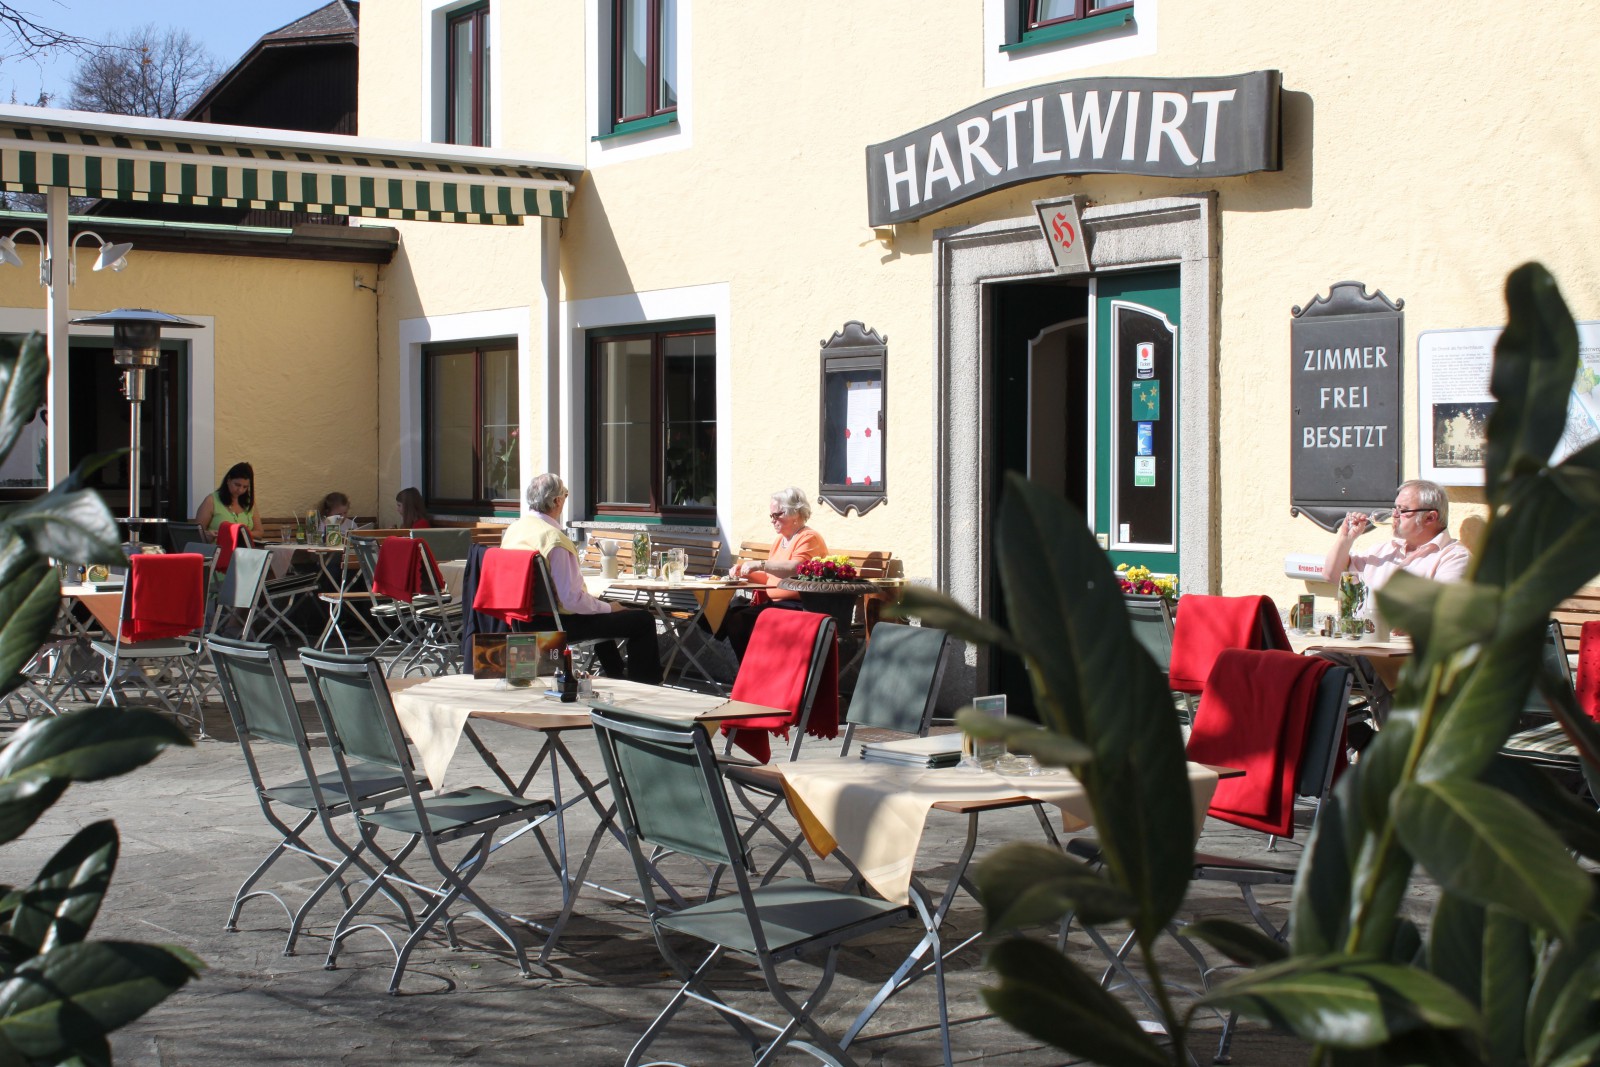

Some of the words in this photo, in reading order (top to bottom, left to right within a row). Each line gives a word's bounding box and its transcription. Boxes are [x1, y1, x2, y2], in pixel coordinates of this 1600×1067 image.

[883, 88, 1237, 213] HARTLWIRT
[1303, 346, 1388, 371] ZIMMER
[1320, 386, 1368, 409] FREI
[1303, 425, 1388, 448] BESETZT
